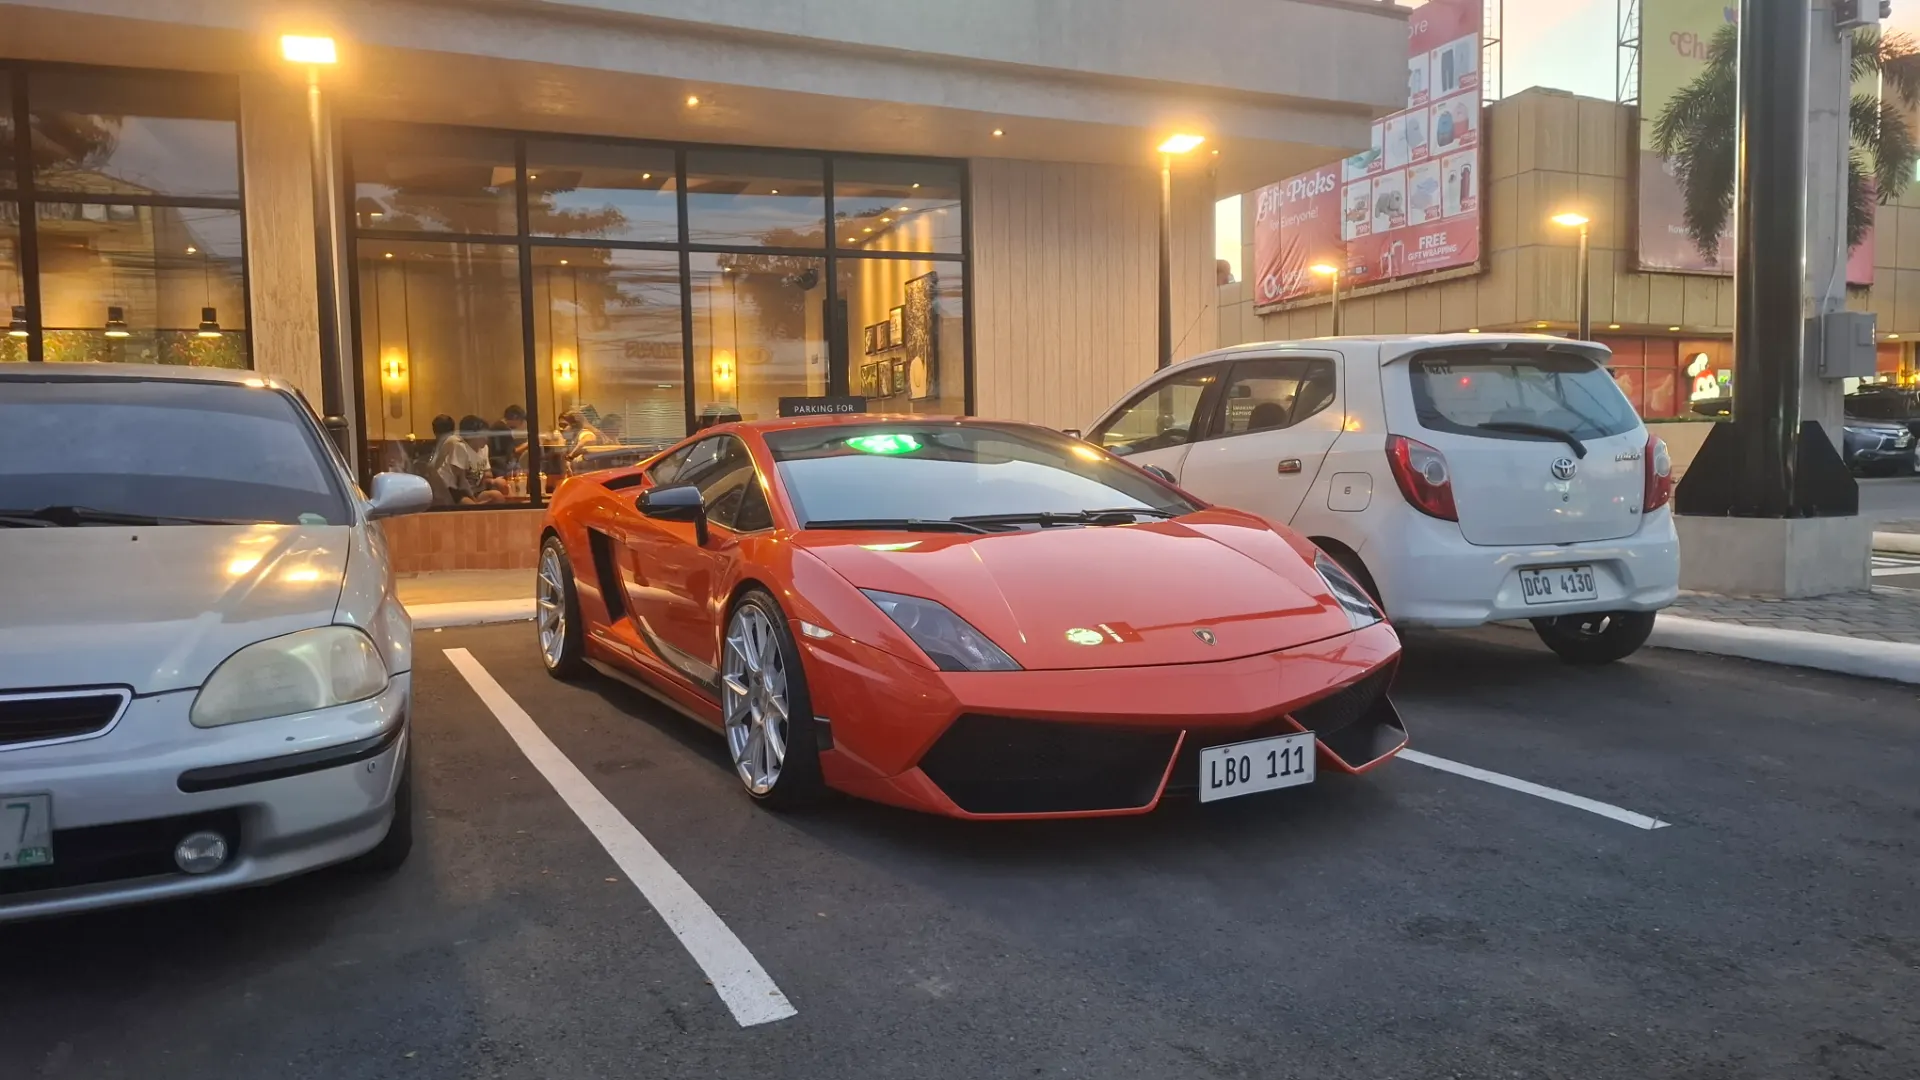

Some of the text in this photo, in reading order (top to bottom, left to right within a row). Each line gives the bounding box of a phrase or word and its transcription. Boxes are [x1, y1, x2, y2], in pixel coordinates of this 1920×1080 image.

[1408, 20, 1428, 39] ore
[1669, 31, 1708, 60] Ch
[1256, 171, 1336, 226] Gift Picks
[1419, 232, 1447, 250] FREE
[794, 404, 854, 413] PARKING FOR
[1524, 573, 1593, 596] DCQ 4130
[1211, 746, 1304, 789] LBO 111
[6, 803, 30, 844] 7
